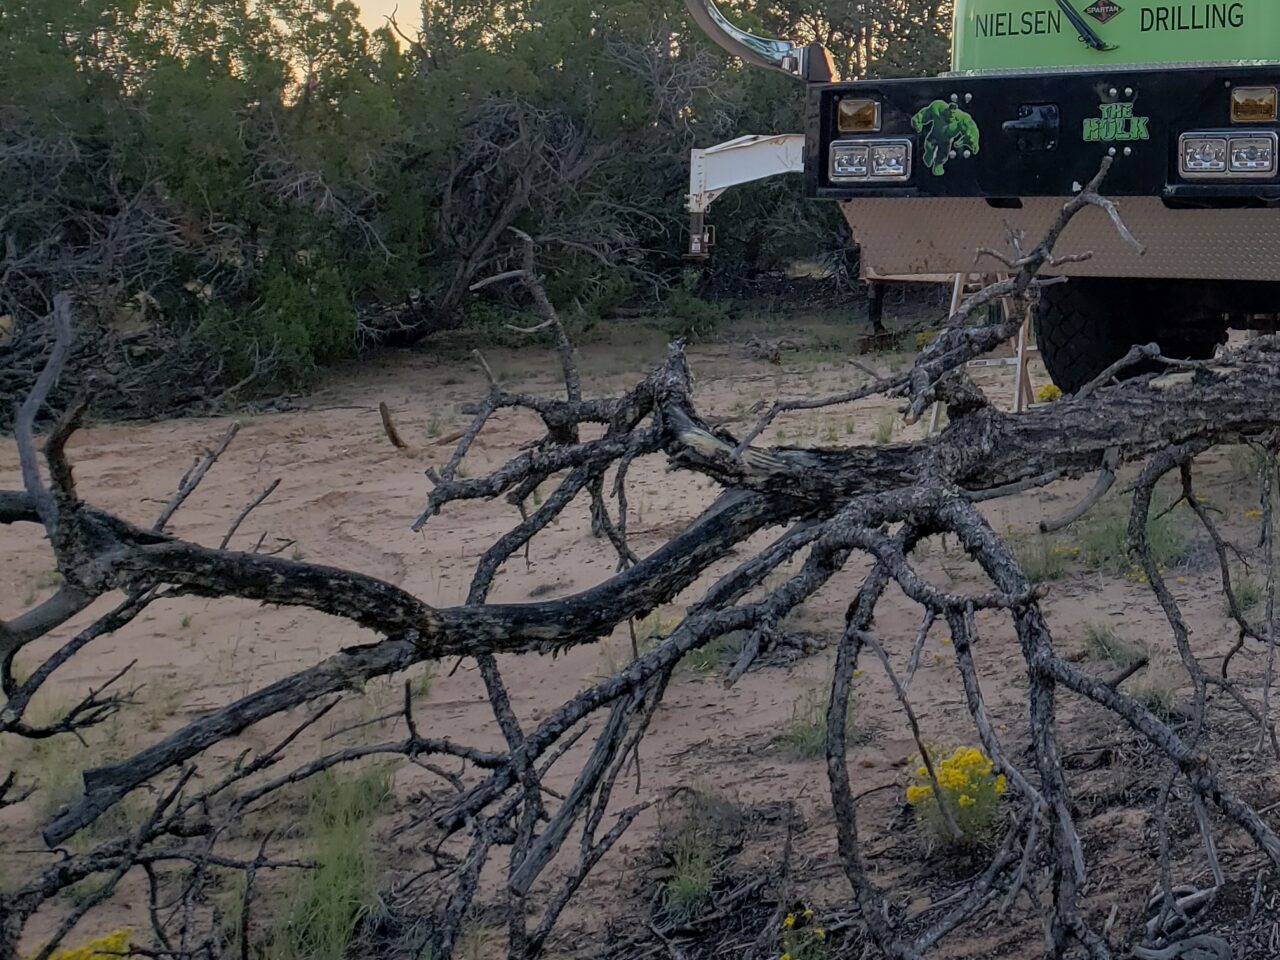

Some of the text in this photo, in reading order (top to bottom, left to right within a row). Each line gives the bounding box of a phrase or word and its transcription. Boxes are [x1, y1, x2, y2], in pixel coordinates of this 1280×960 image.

[975, 2, 1244, 38] NIELSEN DRILLING
[1086, 6, 1119, 14] SPARTAN
[1099, 102, 1133, 119] THE
[1083, 116, 1150, 141] HULK
